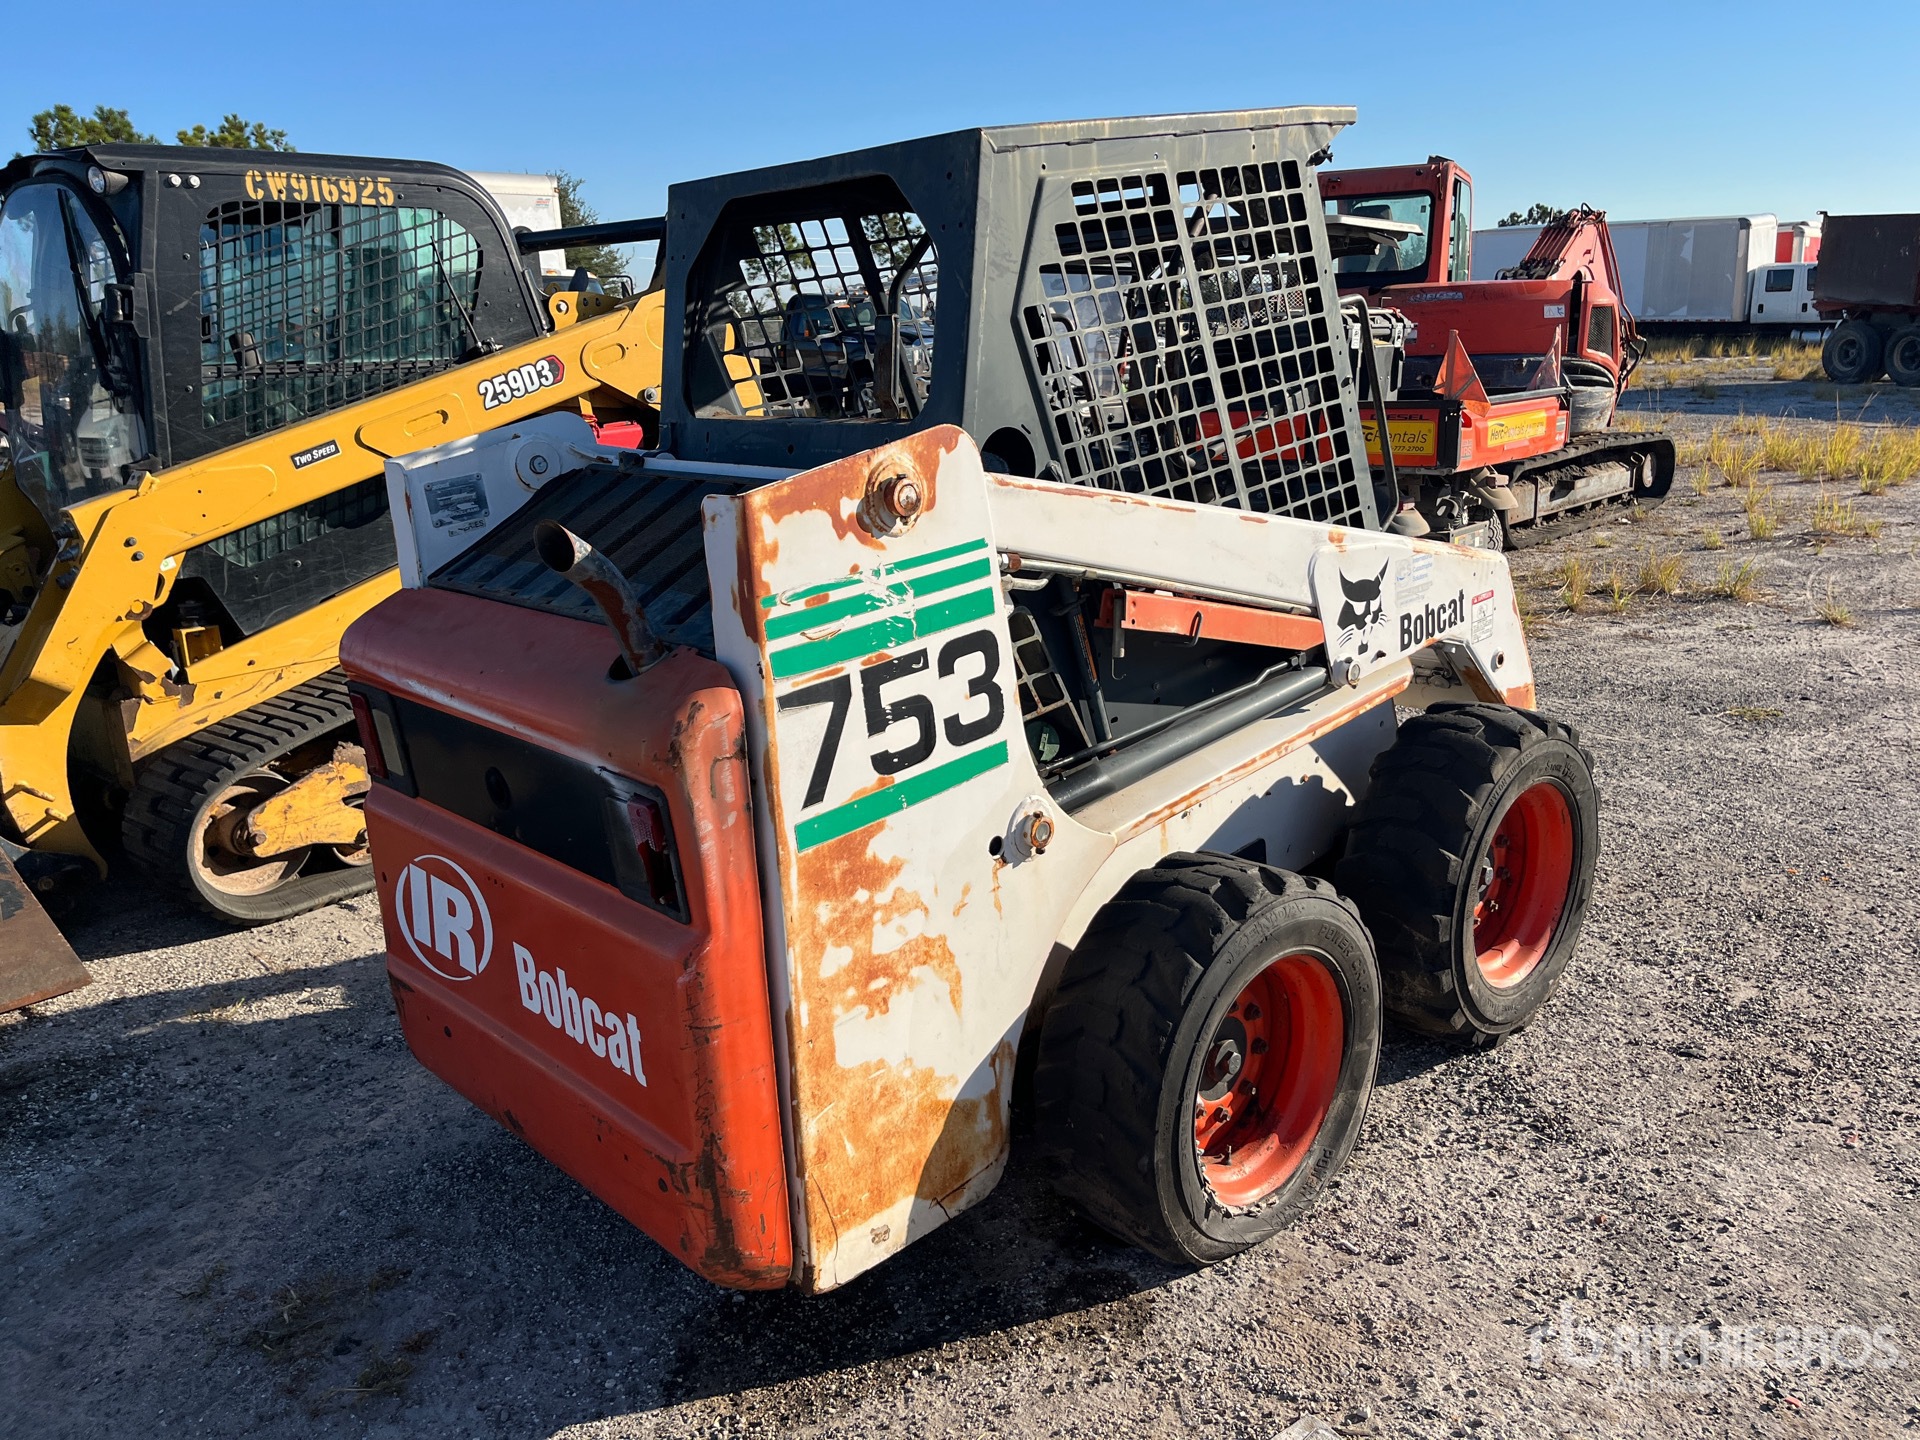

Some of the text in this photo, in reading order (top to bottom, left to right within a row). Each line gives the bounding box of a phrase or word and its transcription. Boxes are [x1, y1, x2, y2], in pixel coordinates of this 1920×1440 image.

[245, 169, 395, 206] CW916925
[478, 358, 555, 410] 259D3
[1400, 588, 1465, 653] Bobcat
[777, 628, 1004, 812] 753
[409, 863, 478, 976] IR
[513, 941, 648, 1088] Bobcat
